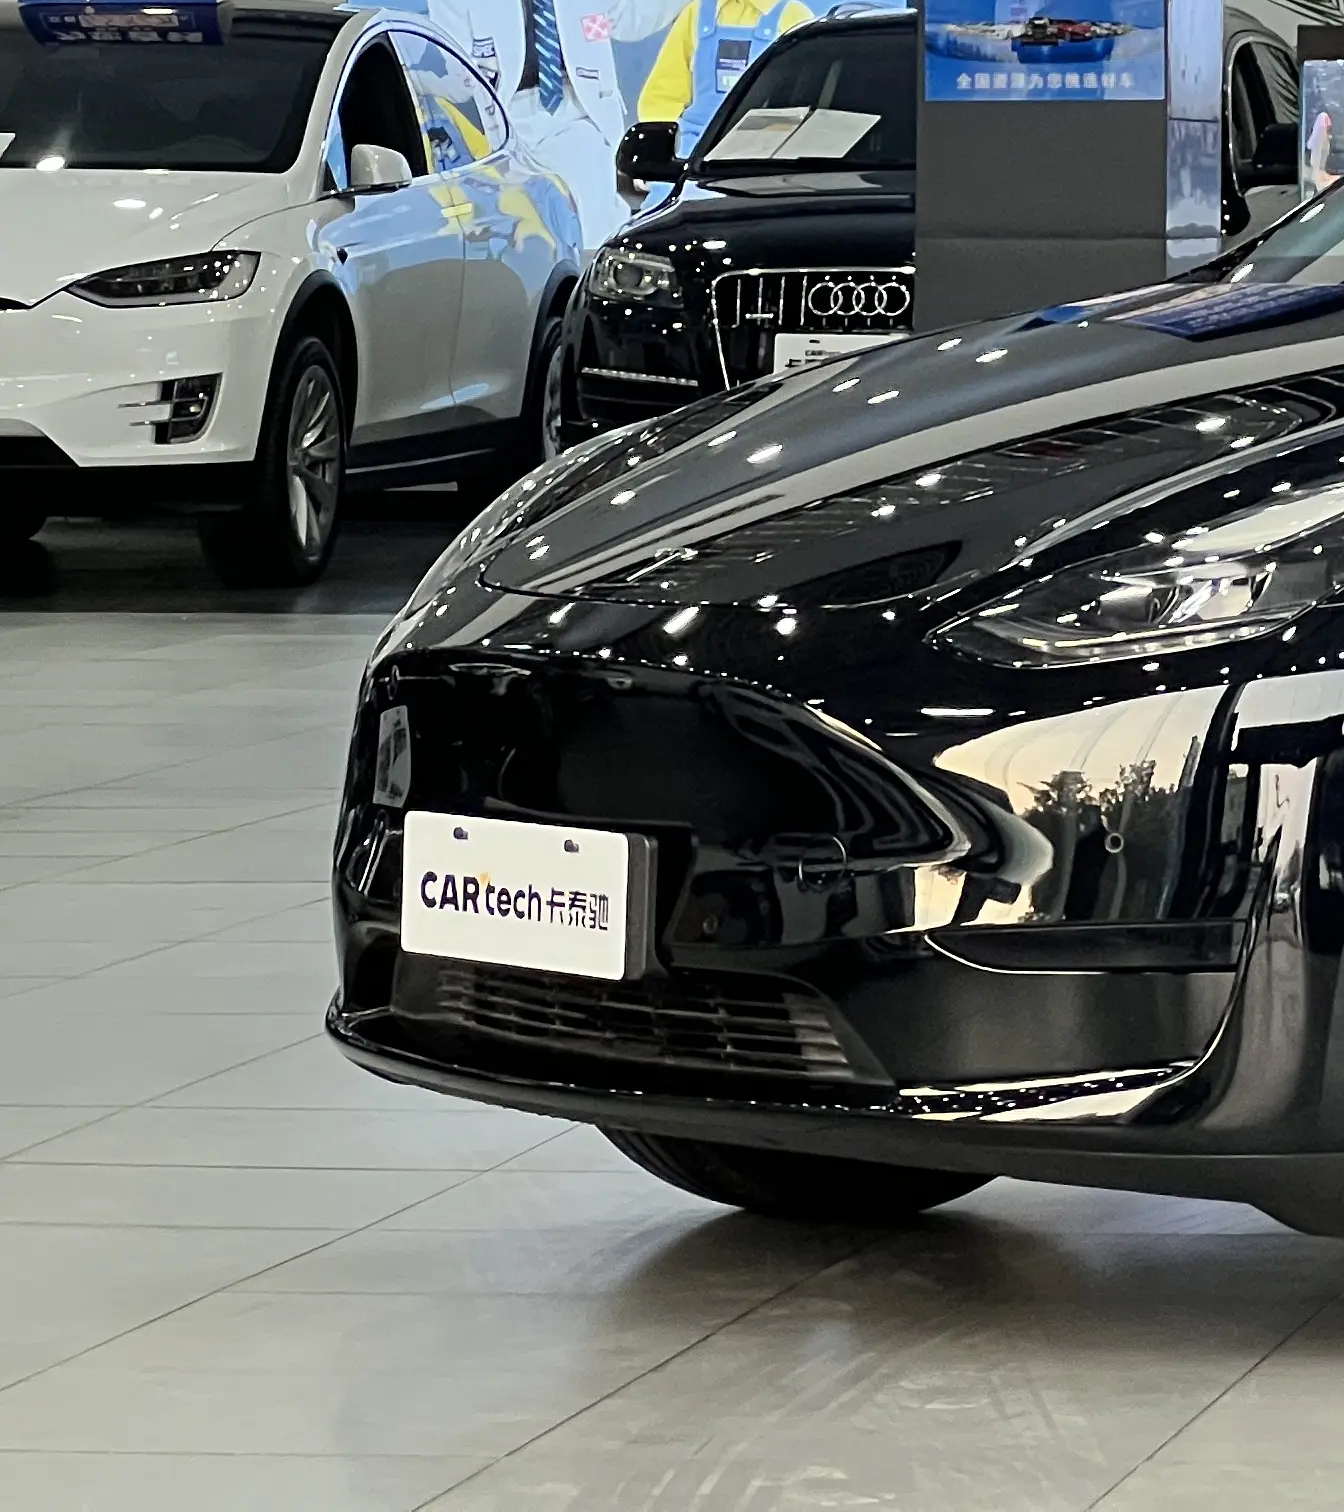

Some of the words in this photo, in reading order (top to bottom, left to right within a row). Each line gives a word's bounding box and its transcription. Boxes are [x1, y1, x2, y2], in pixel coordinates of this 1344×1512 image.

[420, 871, 542, 922] CARtech
[546, 887, 609, 931] 卡泰驰
